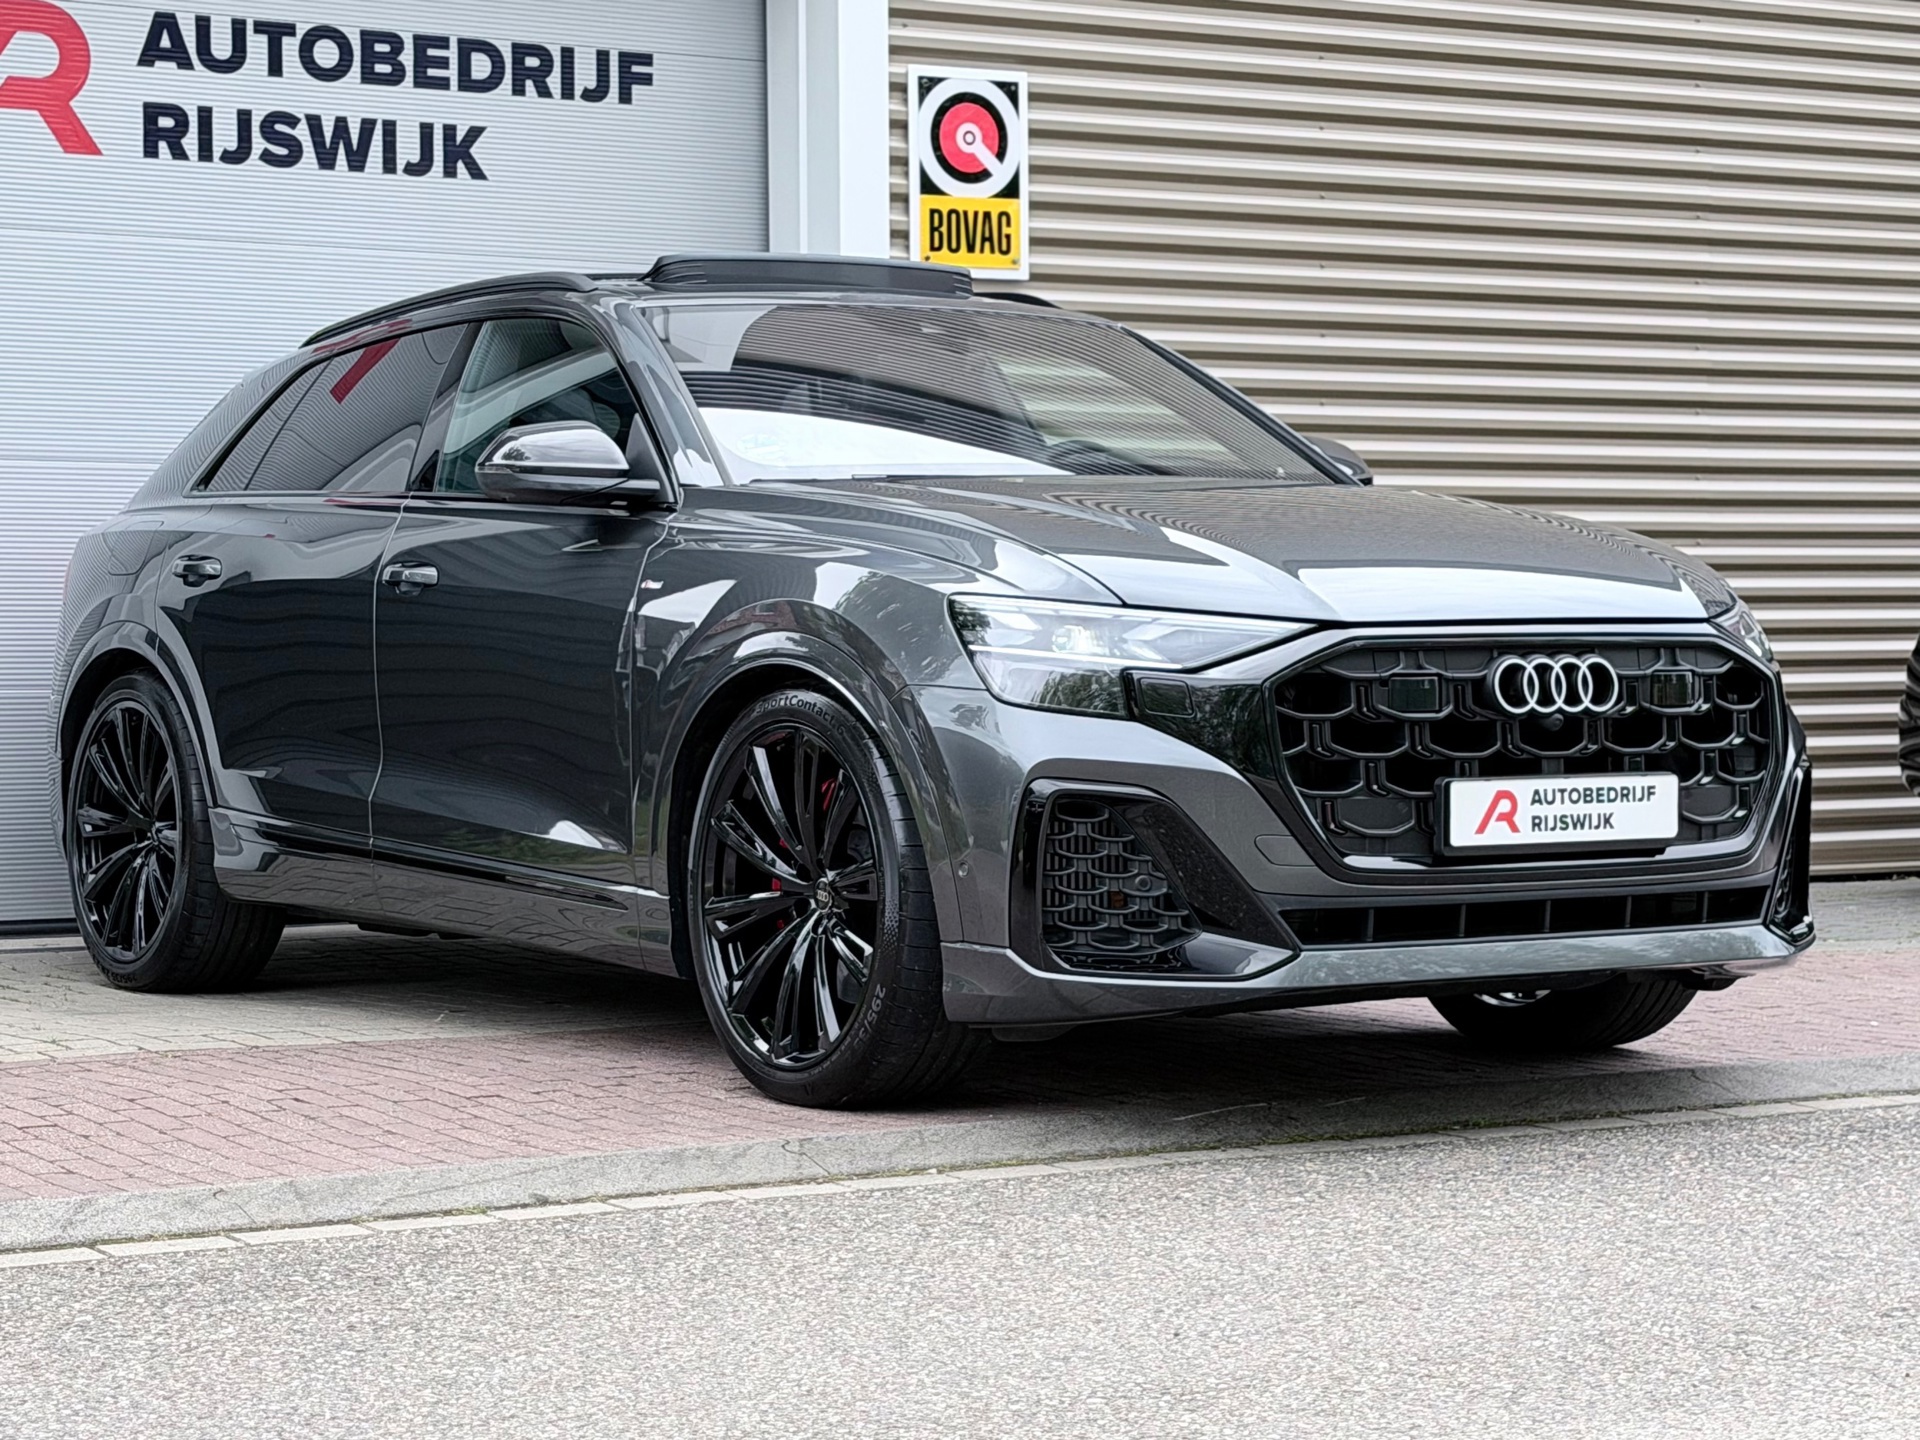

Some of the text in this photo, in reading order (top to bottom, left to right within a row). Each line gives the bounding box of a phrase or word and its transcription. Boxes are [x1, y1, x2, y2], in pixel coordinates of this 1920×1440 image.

[137, 11, 654, 105] AUTOBEDRIJF
[142, 102, 489, 181] RIJSWIJK
[929, 208, 1012, 256] BOVAG
[1530, 785, 1656, 806] AUTOBEDRIJF
[1531, 812, 1615, 833] RIJSWIJK
